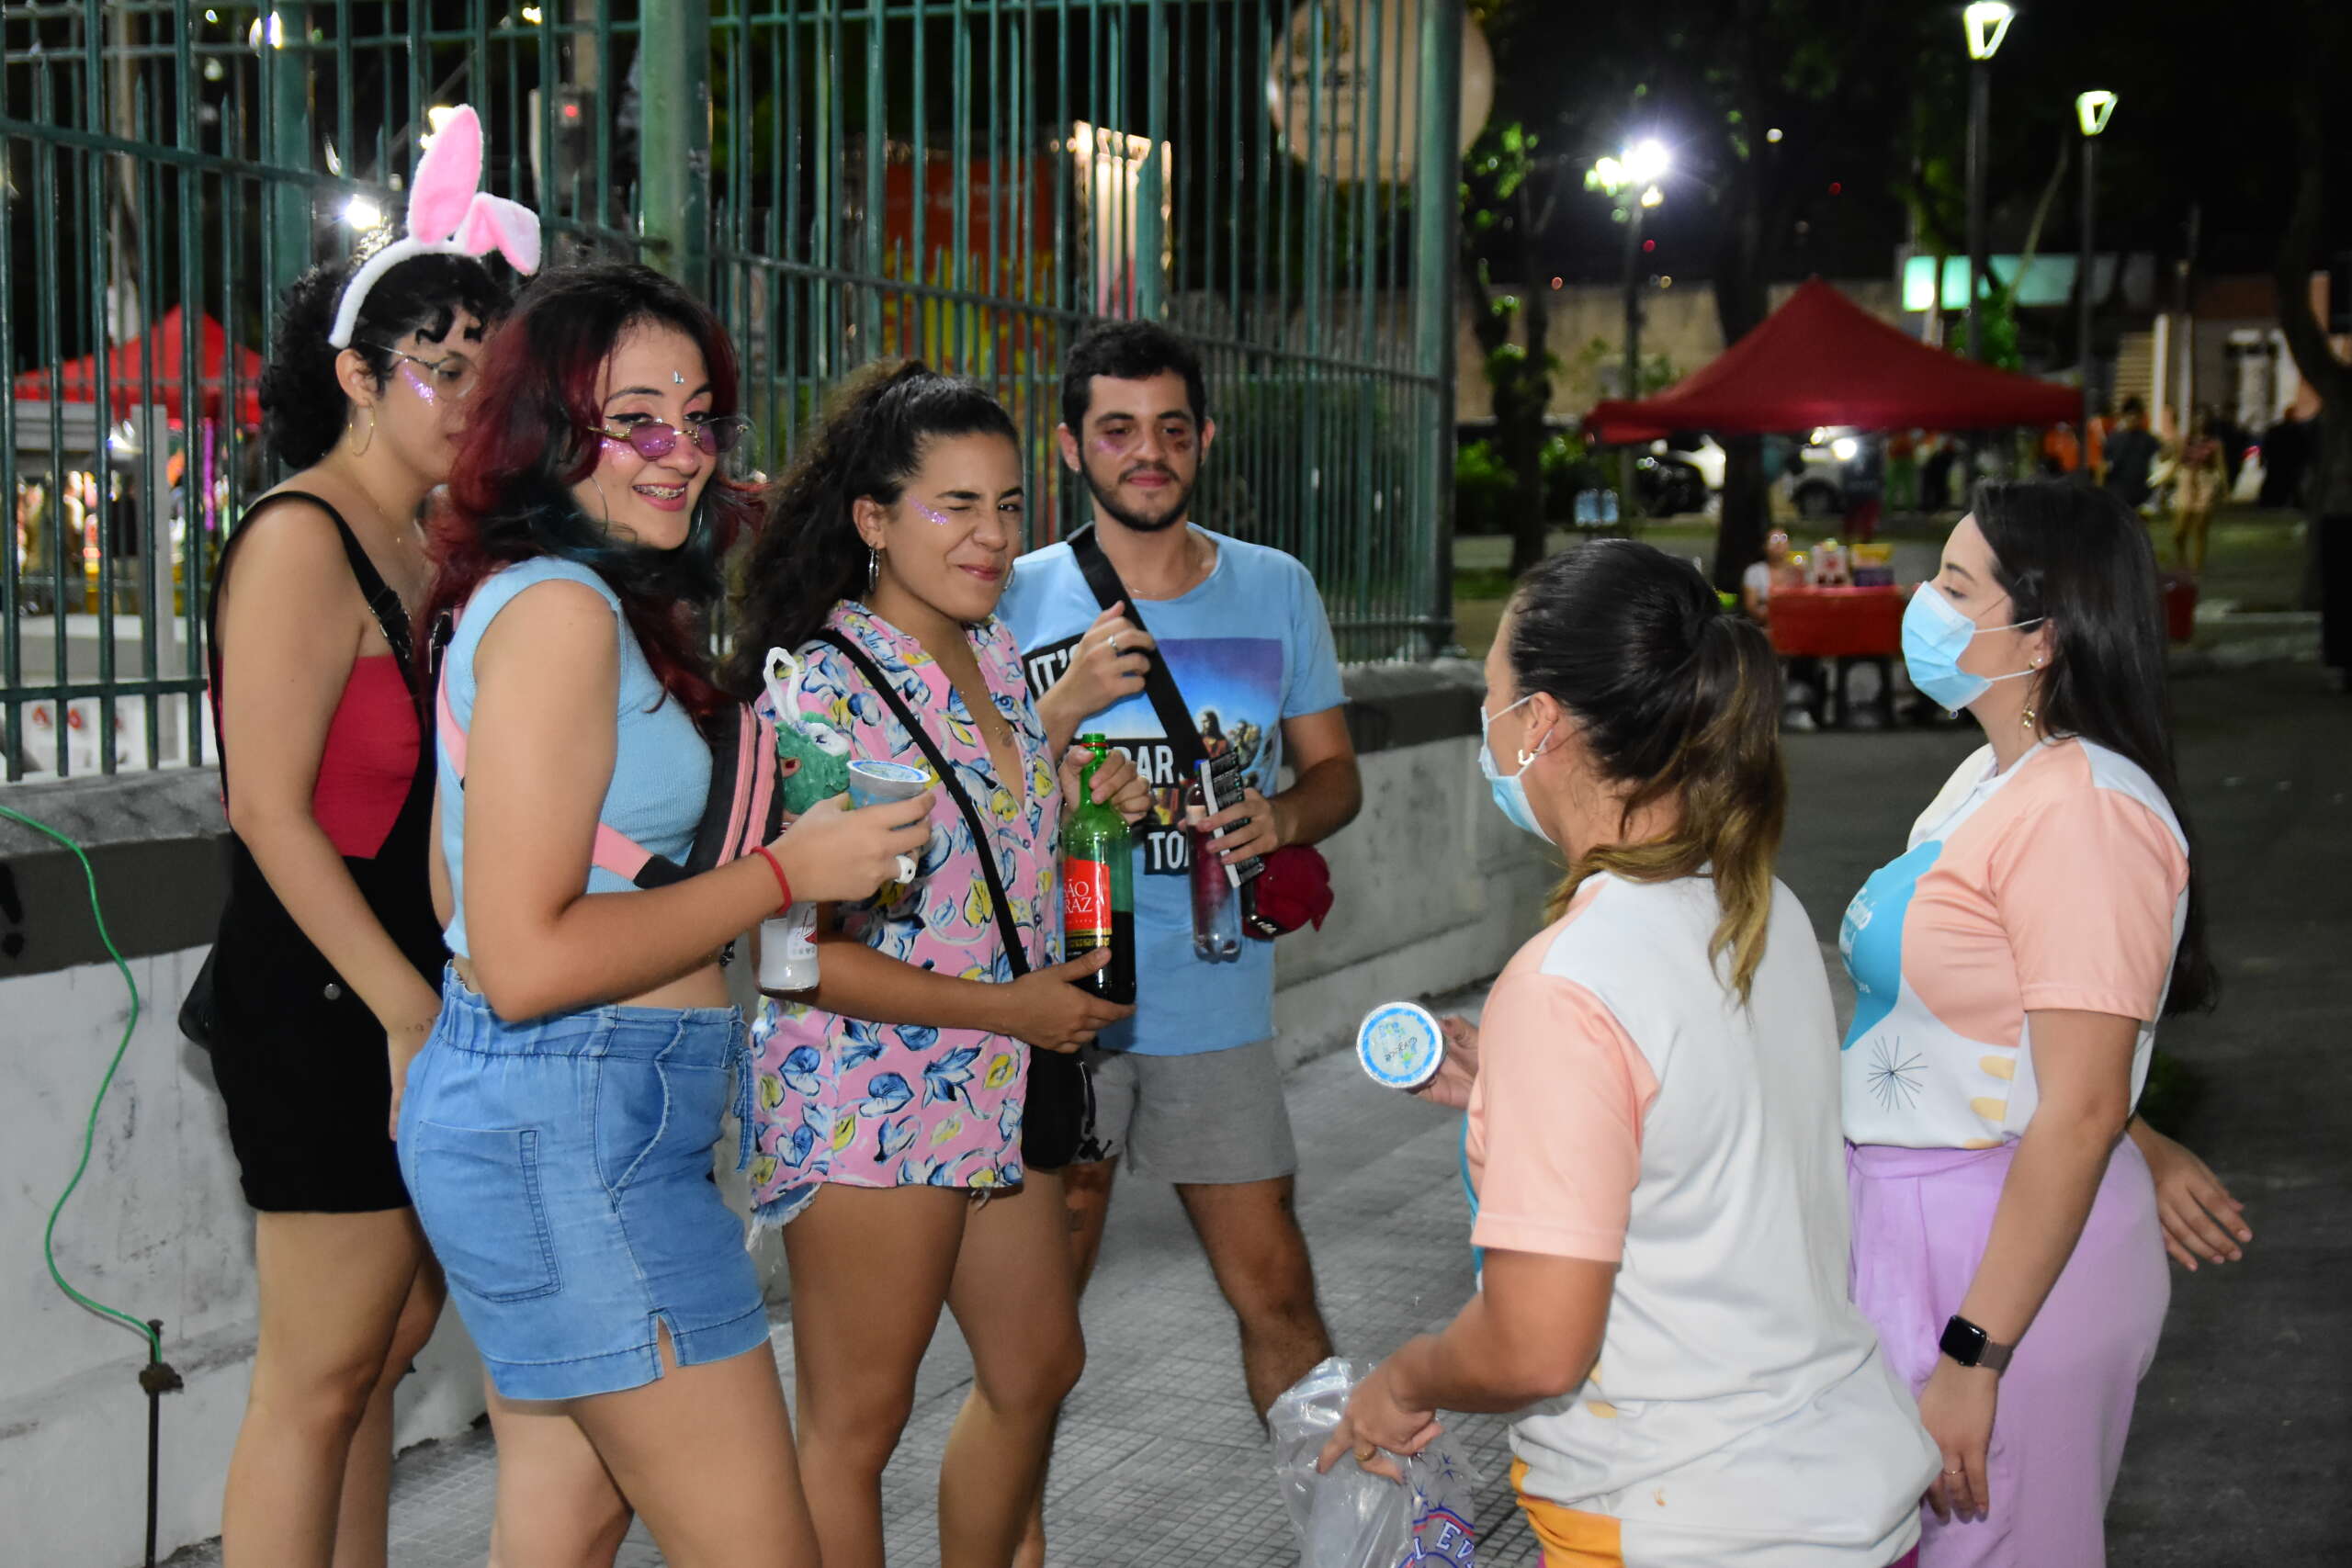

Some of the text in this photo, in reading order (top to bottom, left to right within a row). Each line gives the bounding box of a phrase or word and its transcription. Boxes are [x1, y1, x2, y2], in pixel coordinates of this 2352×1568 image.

[1028, 643, 1080, 696] IT'
[1148, 830, 1189, 870] TO
[1065, 897, 1093, 913] RAZ
